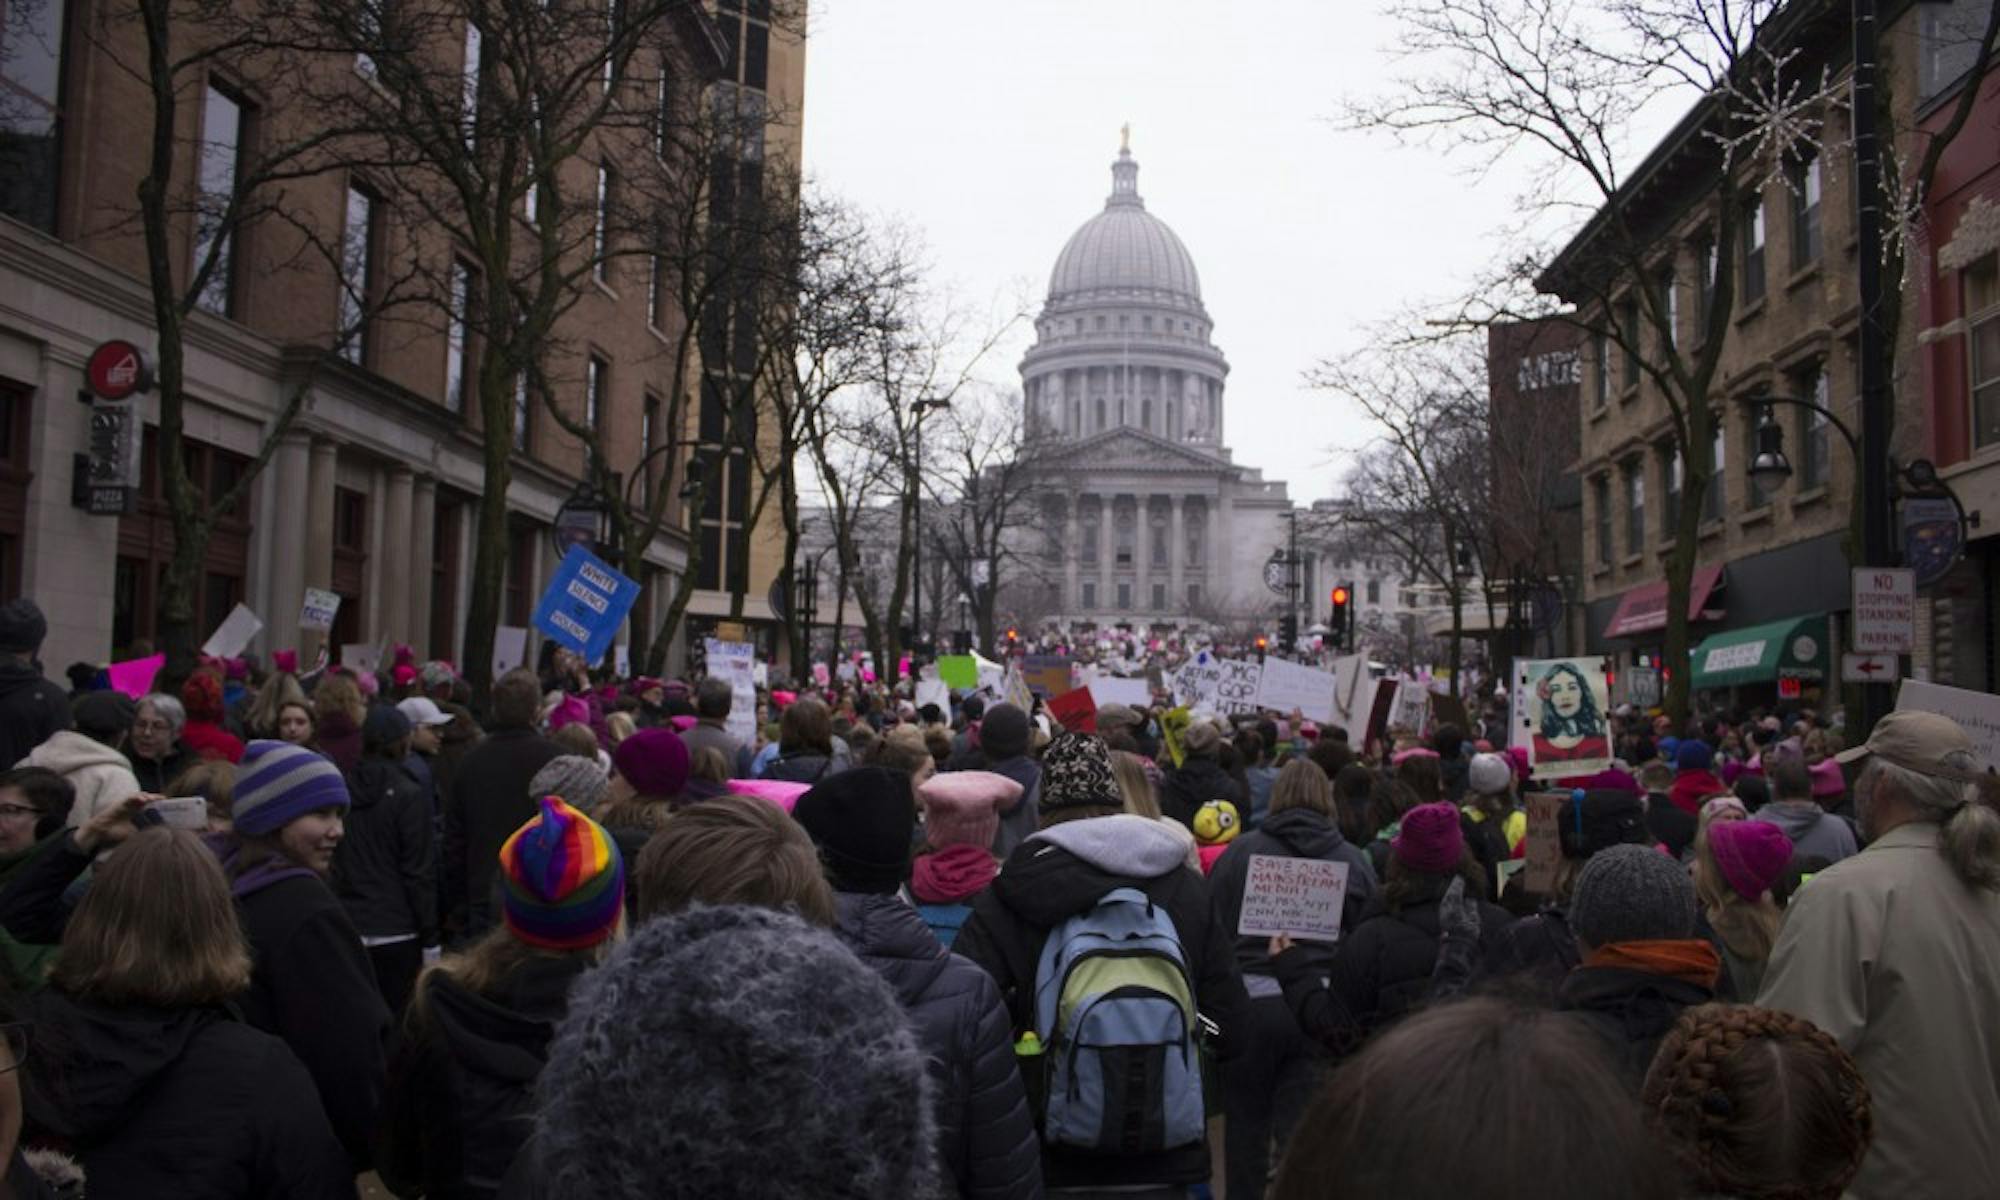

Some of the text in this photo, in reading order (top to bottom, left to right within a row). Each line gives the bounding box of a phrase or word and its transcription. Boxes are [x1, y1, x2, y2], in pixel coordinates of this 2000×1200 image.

[581, 564, 615, 592] WHITE
[1873, 575, 1893, 590] NO
[571, 583, 607, 611] SILENCE
[1857, 593, 1911, 606] STOPPING
[1857, 608, 1911, 622] STANDING
[552, 612, 589, 641] VIOLENCE
[1861, 632, 1910, 646] PARKING
[1222, 662, 1258, 685] OMG
[1217, 680, 1255, 699] GOP
[1254, 858, 1335, 877] SAVE OUR
[1251, 873, 1341, 891] MAINSTREAM
[1246, 908, 1278, 918] CNN,
